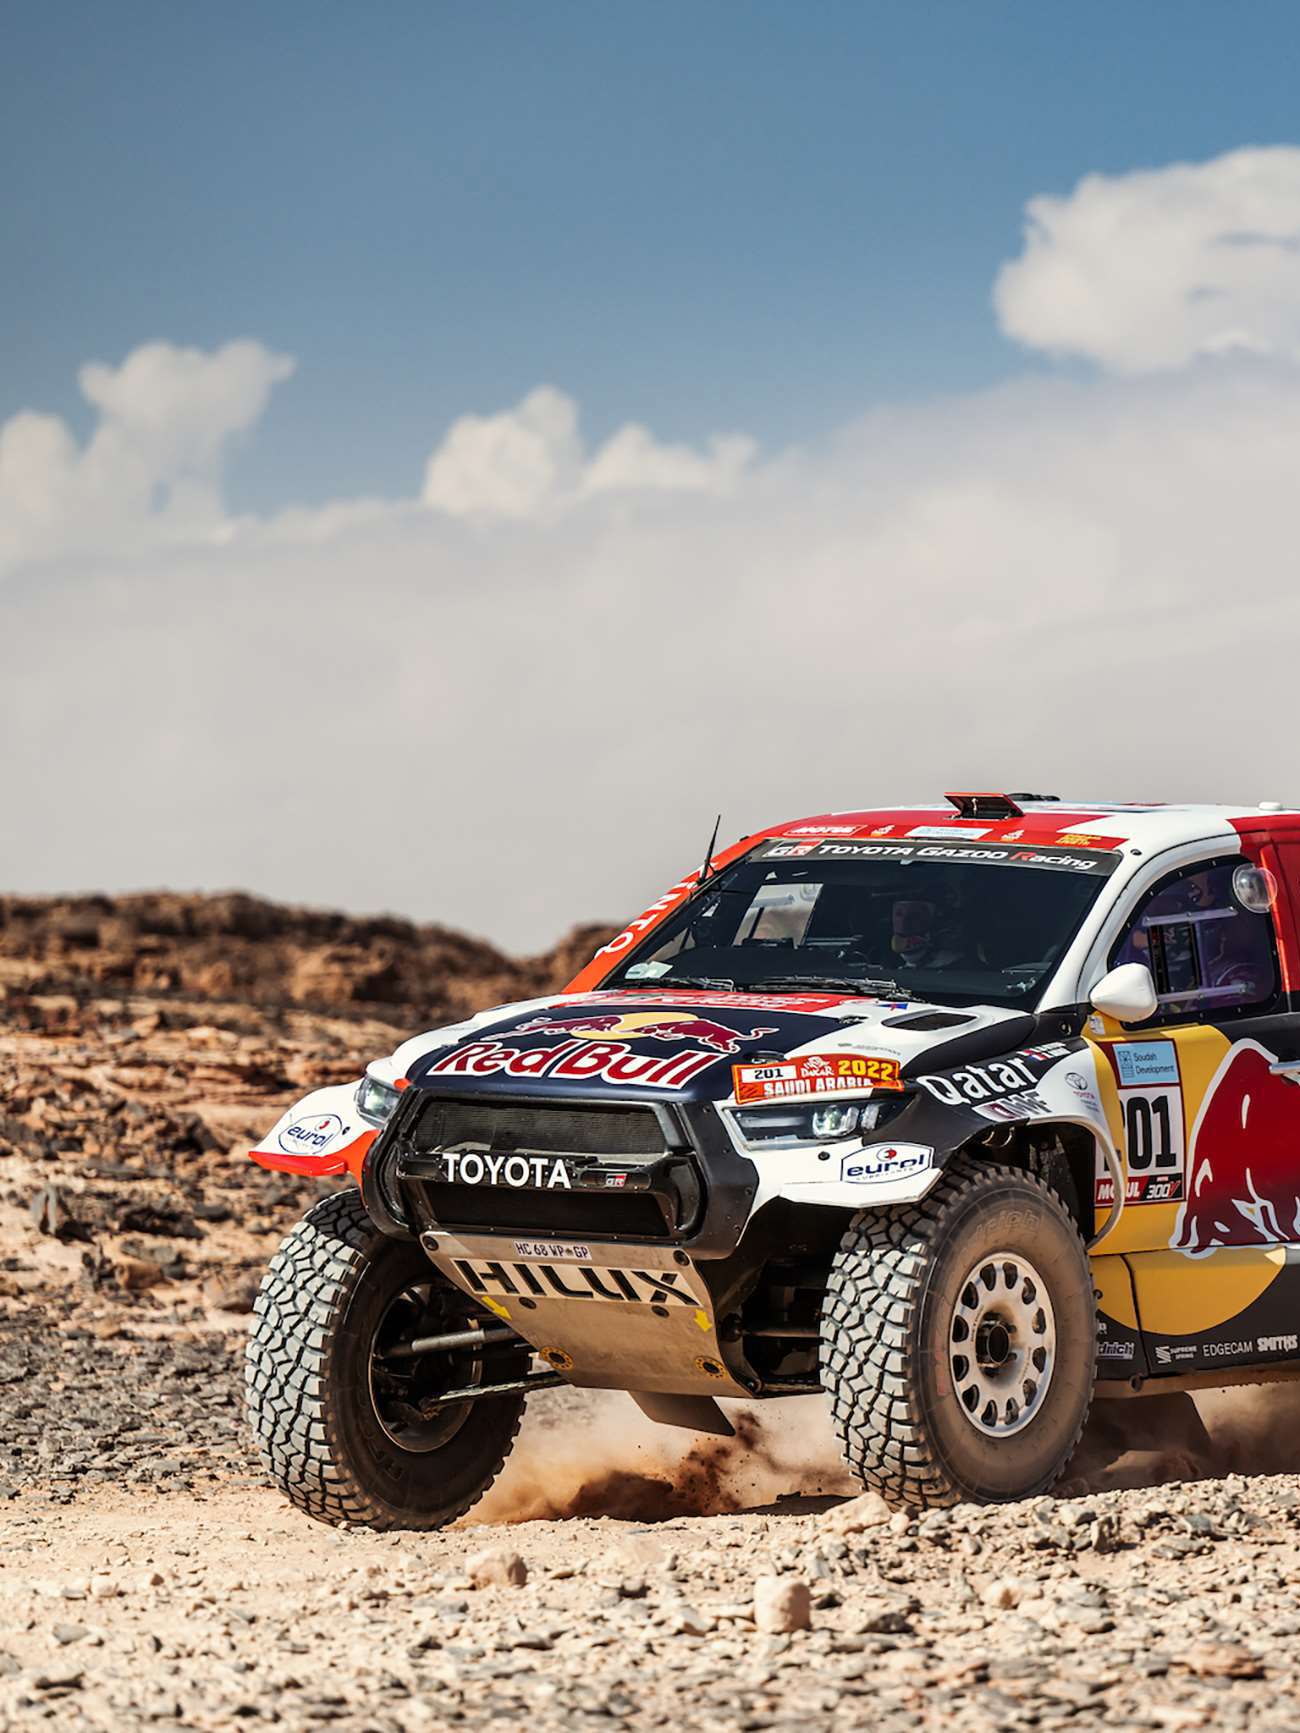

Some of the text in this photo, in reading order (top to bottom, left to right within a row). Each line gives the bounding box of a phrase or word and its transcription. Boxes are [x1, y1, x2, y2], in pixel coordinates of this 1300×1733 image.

[766, 845, 1098, 870] GR TOYOTA GAZOO Racing
[427, 1040, 729, 1090] Red Bull
[1133, 1052, 1157, 1062] Soudah
[754, 1068, 784, 1080] 201
[838, 1059, 894, 1081] 2022
[1136, 1064, 1175, 1074] Development
[764, 1075, 874, 1097] SAUDI ARABIA
[915, 1057, 1039, 1106] Qatar
[287, 1126, 334, 1147] eurol
[1104, 1095, 1177, 1171] 01
[442, 1152, 572, 1189] TOYOTA
[847, 1154, 925, 1177] eurol
[1097, 1180, 1181, 1200] MUL 300V
[515, 1242, 532, 1255] HC
[534, 1244, 549, 1256] 68
[573, 1246, 589, 1258] GP
[454, 1259, 702, 1307] HILUX
[1202, 1342, 1253, 1357] EDGECAM
[1256, 1334, 1298, 1352] SMITHS
